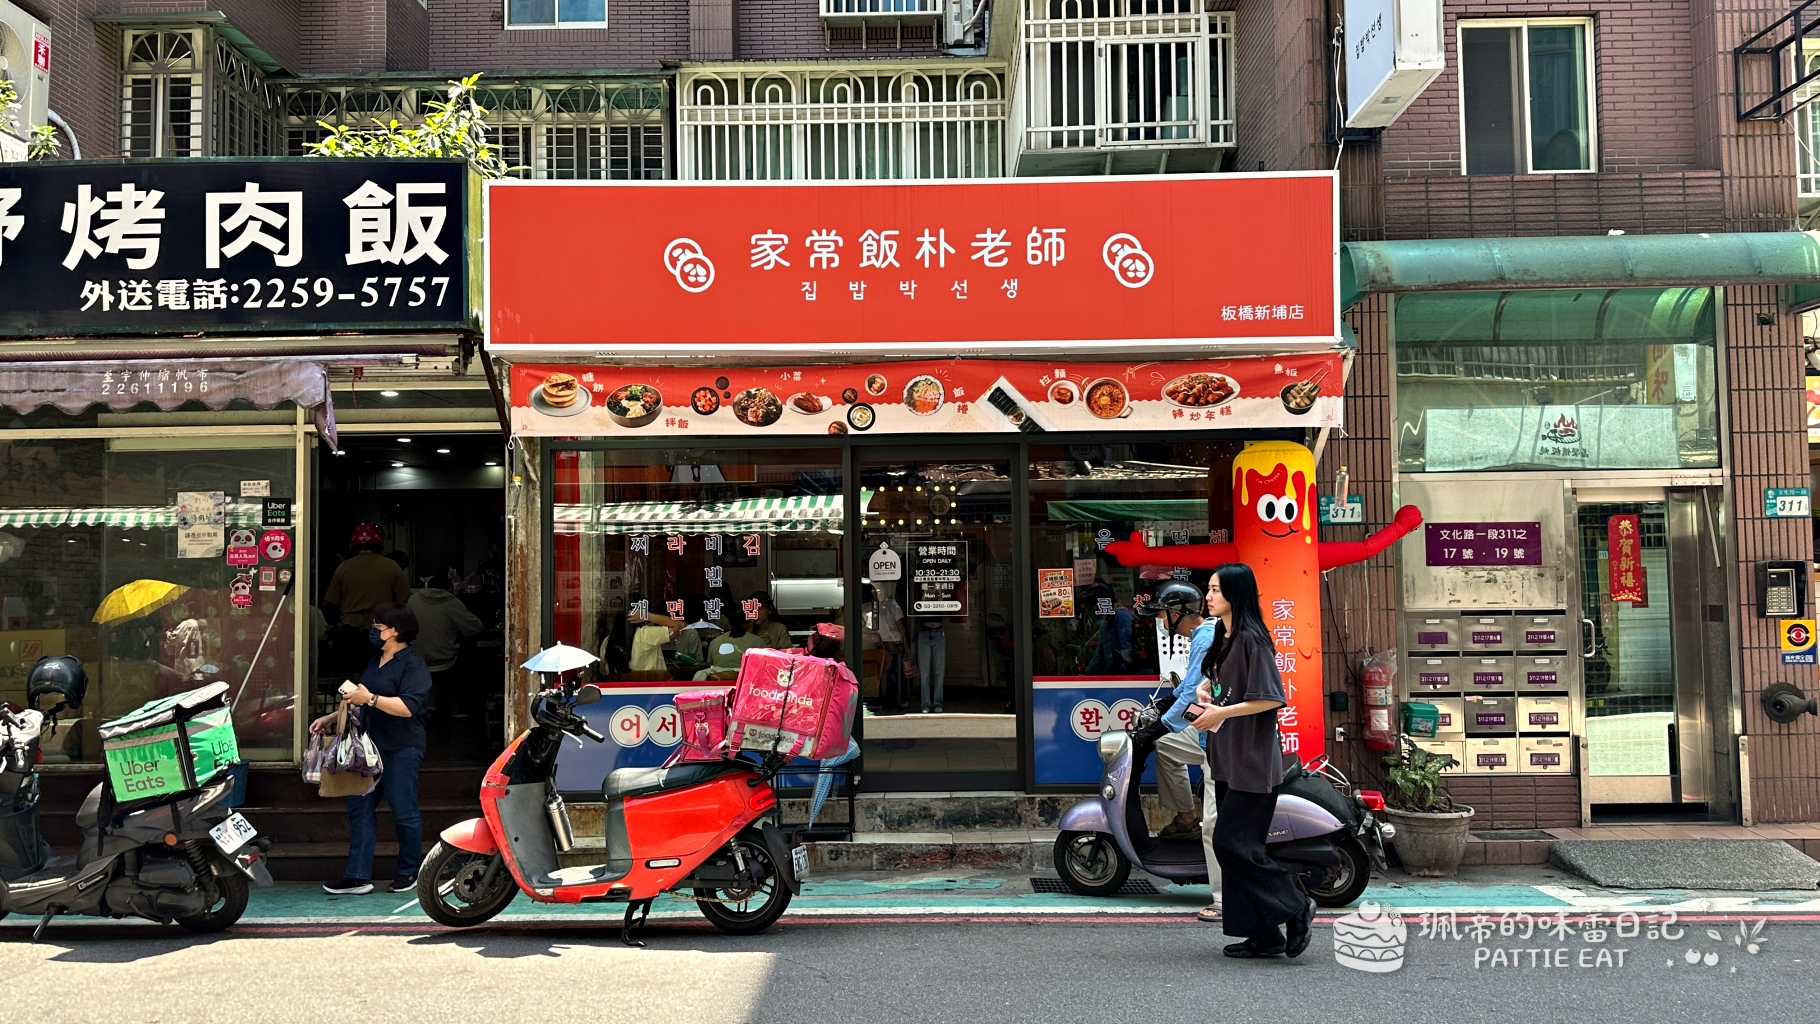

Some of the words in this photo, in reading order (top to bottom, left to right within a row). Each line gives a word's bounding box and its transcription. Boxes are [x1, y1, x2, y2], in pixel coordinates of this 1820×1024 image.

[0, 180, 449, 271] 烤肉飯
[749, 226, 1067, 271] 家常飯朴老師
[1220, 304, 1305, 321] 板橋新埔店
[780, 371, 803, 382] 小菜
[1039, 368, 1067, 387] 拉麵
[1273, 362, 1298, 378] 魚板
[101, 381, 209, 396] 22611196
[1171, 405, 1233, 422] 辣炒年糕
[664, 417, 689, 429] 拌飯
[267, 501, 286, 510] Uber
[267, 509, 286, 517] Eats
[1778, 499, 1802, 512] 311
[1439, 528, 1527, 541] 文化路一段311之
[918, 545, 957, 556] 營業時間
[1443, 548, 1457, 560] 17
[1462, 548, 1474, 560] 號
[1494, 548, 1508, 560] 19
[1513, 547, 1525, 560] 號
[1618, 519, 1636, 588] 恭賀新禧
[873, 561, 897, 570] OPEN
[915, 569, 960, 577] 10:30-21:30
[749, 682, 813, 707] foodpanda
[120, 759, 160, 776] Uber
[124, 775, 166, 793] Eats
